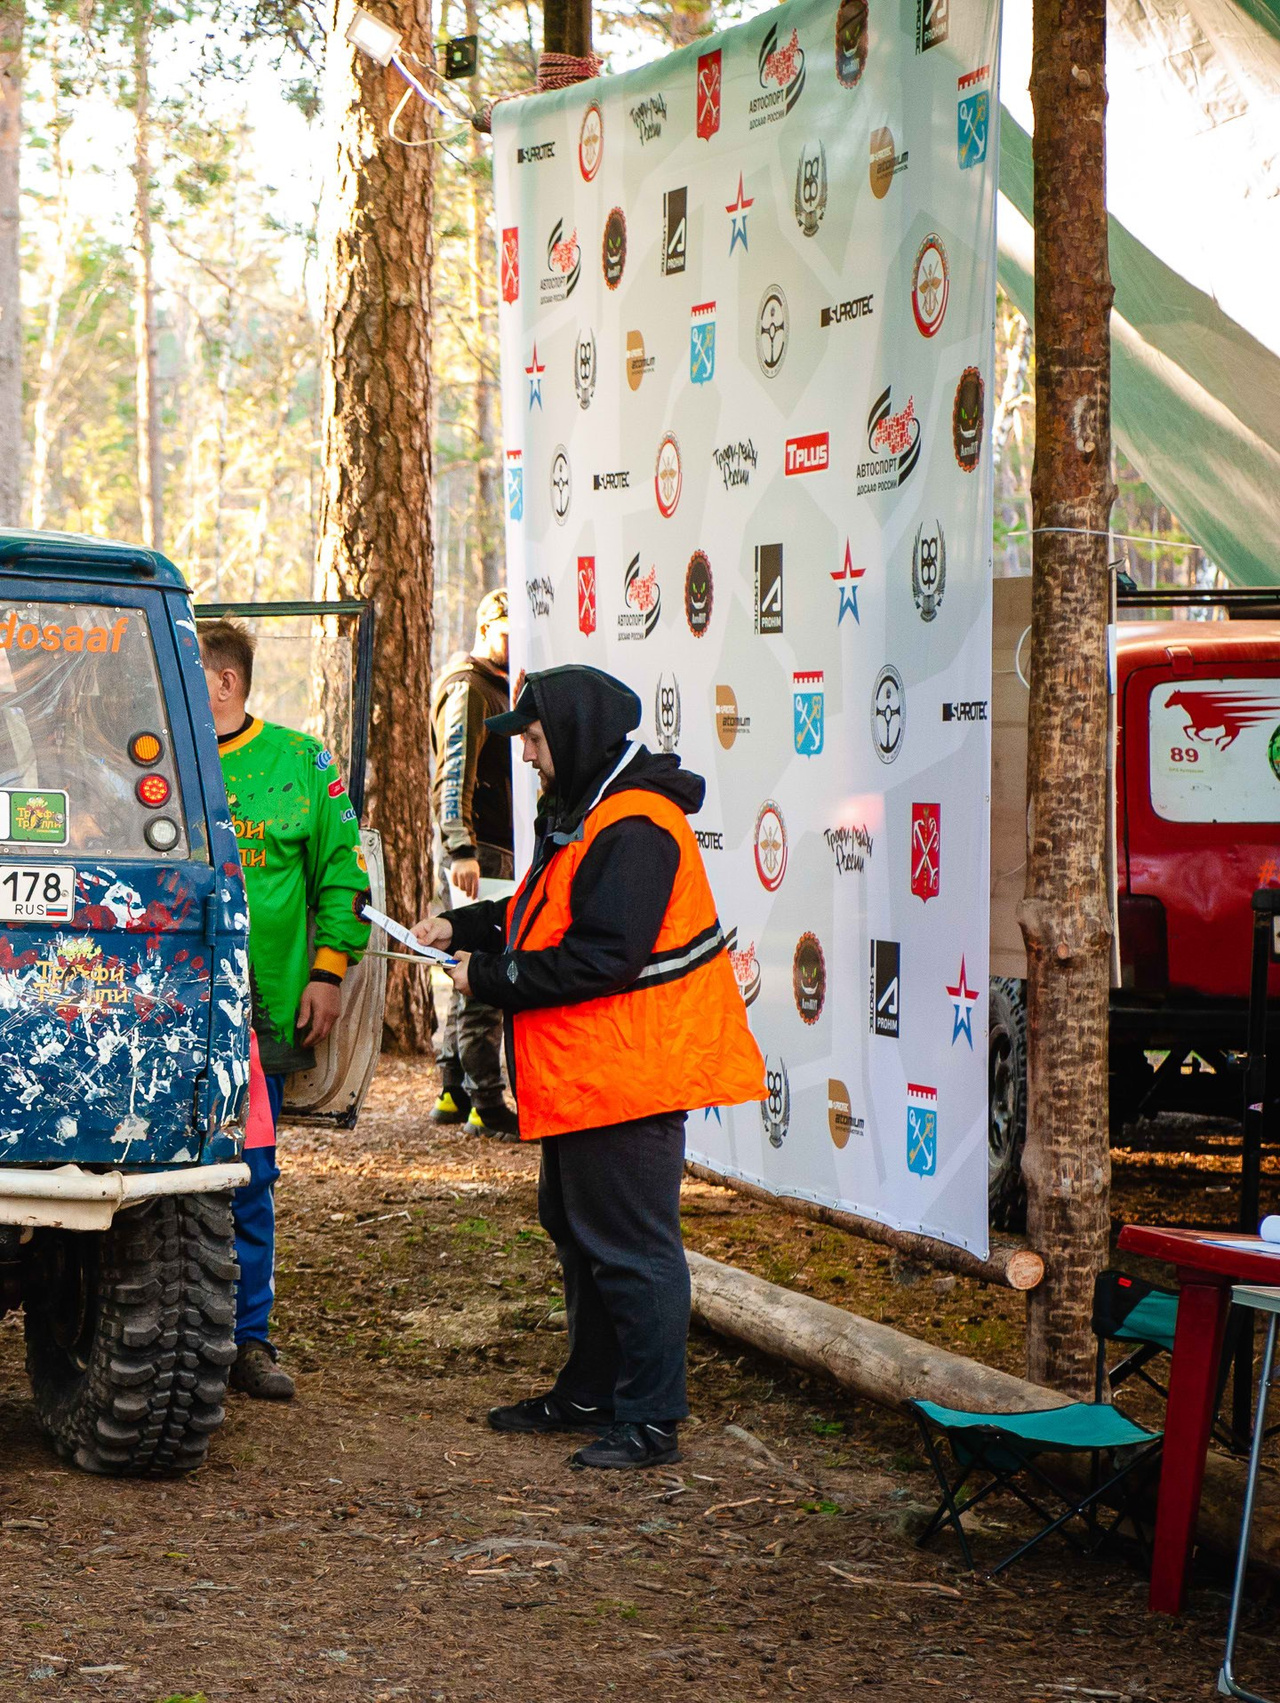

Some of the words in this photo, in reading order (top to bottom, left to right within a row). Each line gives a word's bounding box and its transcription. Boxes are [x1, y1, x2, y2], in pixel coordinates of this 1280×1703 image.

[749, 89, 784, 114] АВТОСПОРТ
[828, 294, 874, 324] SUPROTEC
[856, 457, 897, 479] АВТОСПОРТ
[856, 482, 877, 496] ДОСААФ
[877, 479, 897, 492] РОССИИ
[761, 616, 782, 628] PROHIM
[950, 701, 988, 721] SUPROTEC
[1170, 747, 1199, 763] 89
[694, 831, 723, 850] PROTEC
[2, 871, 61, 903] 178
[15, 904, 44, 915] RUS
[877, 1017, 898, 1031] PROHIM
